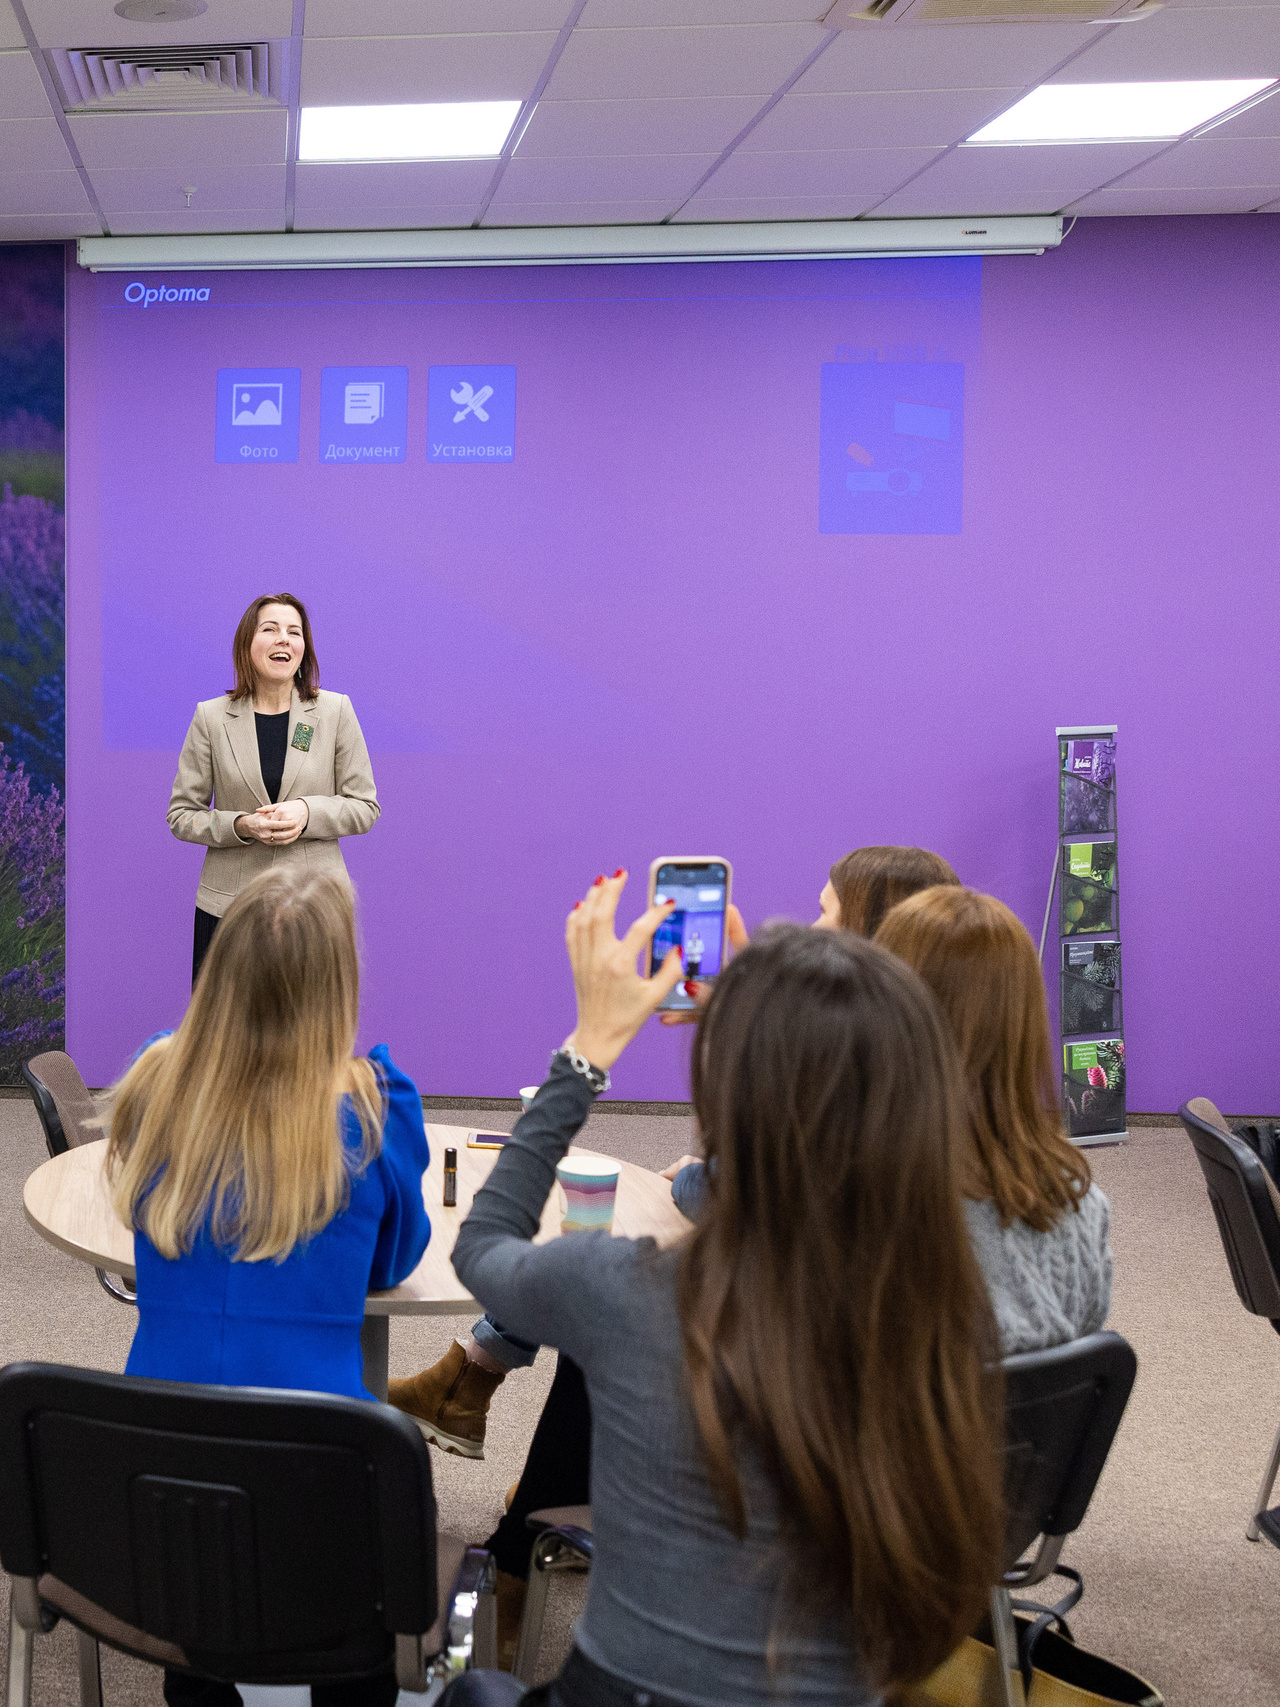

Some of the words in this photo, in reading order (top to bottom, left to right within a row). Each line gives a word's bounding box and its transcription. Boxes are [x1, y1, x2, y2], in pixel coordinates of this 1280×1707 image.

[124, 282, 211, 309] Optoma
[835, 344, 877, 362] Plug
[885, 344, 926, 359] USB
[240, 445, 278, 458] Фото
[325, 444, 400, 460] Документ
[432, 443, 513, 458] Установка
